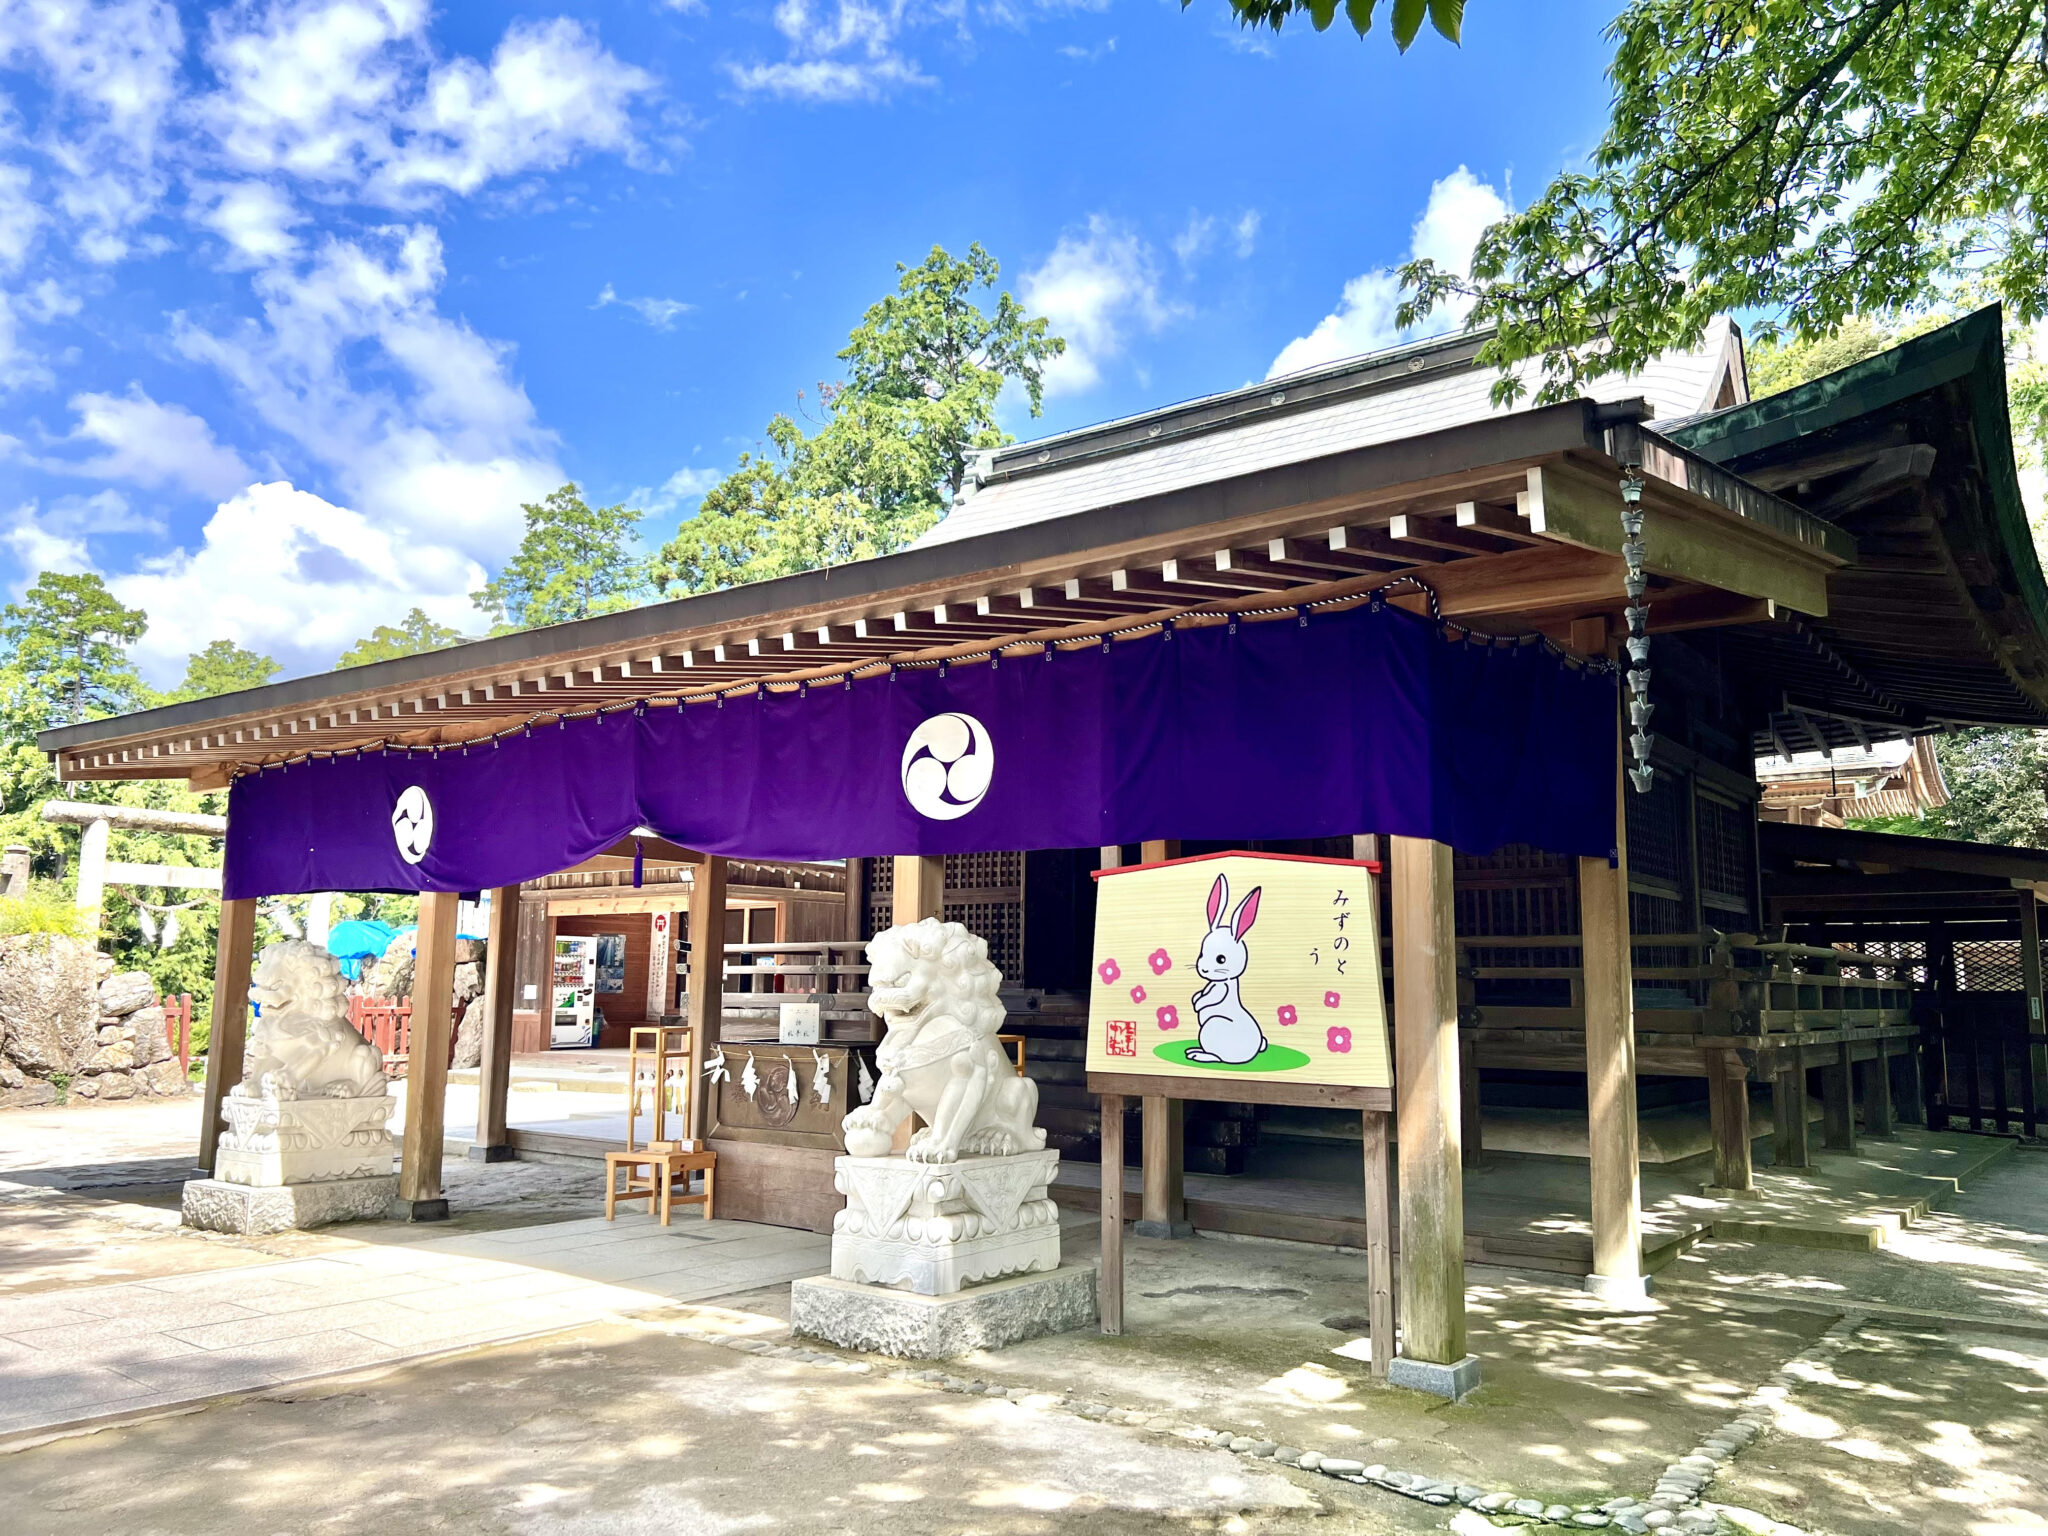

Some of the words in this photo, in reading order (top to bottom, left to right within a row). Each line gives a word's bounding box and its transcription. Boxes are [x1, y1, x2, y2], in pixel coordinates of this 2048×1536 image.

[1309, 947, 1319, 966] う
[1333, 889, 1351, 976] みずのと
